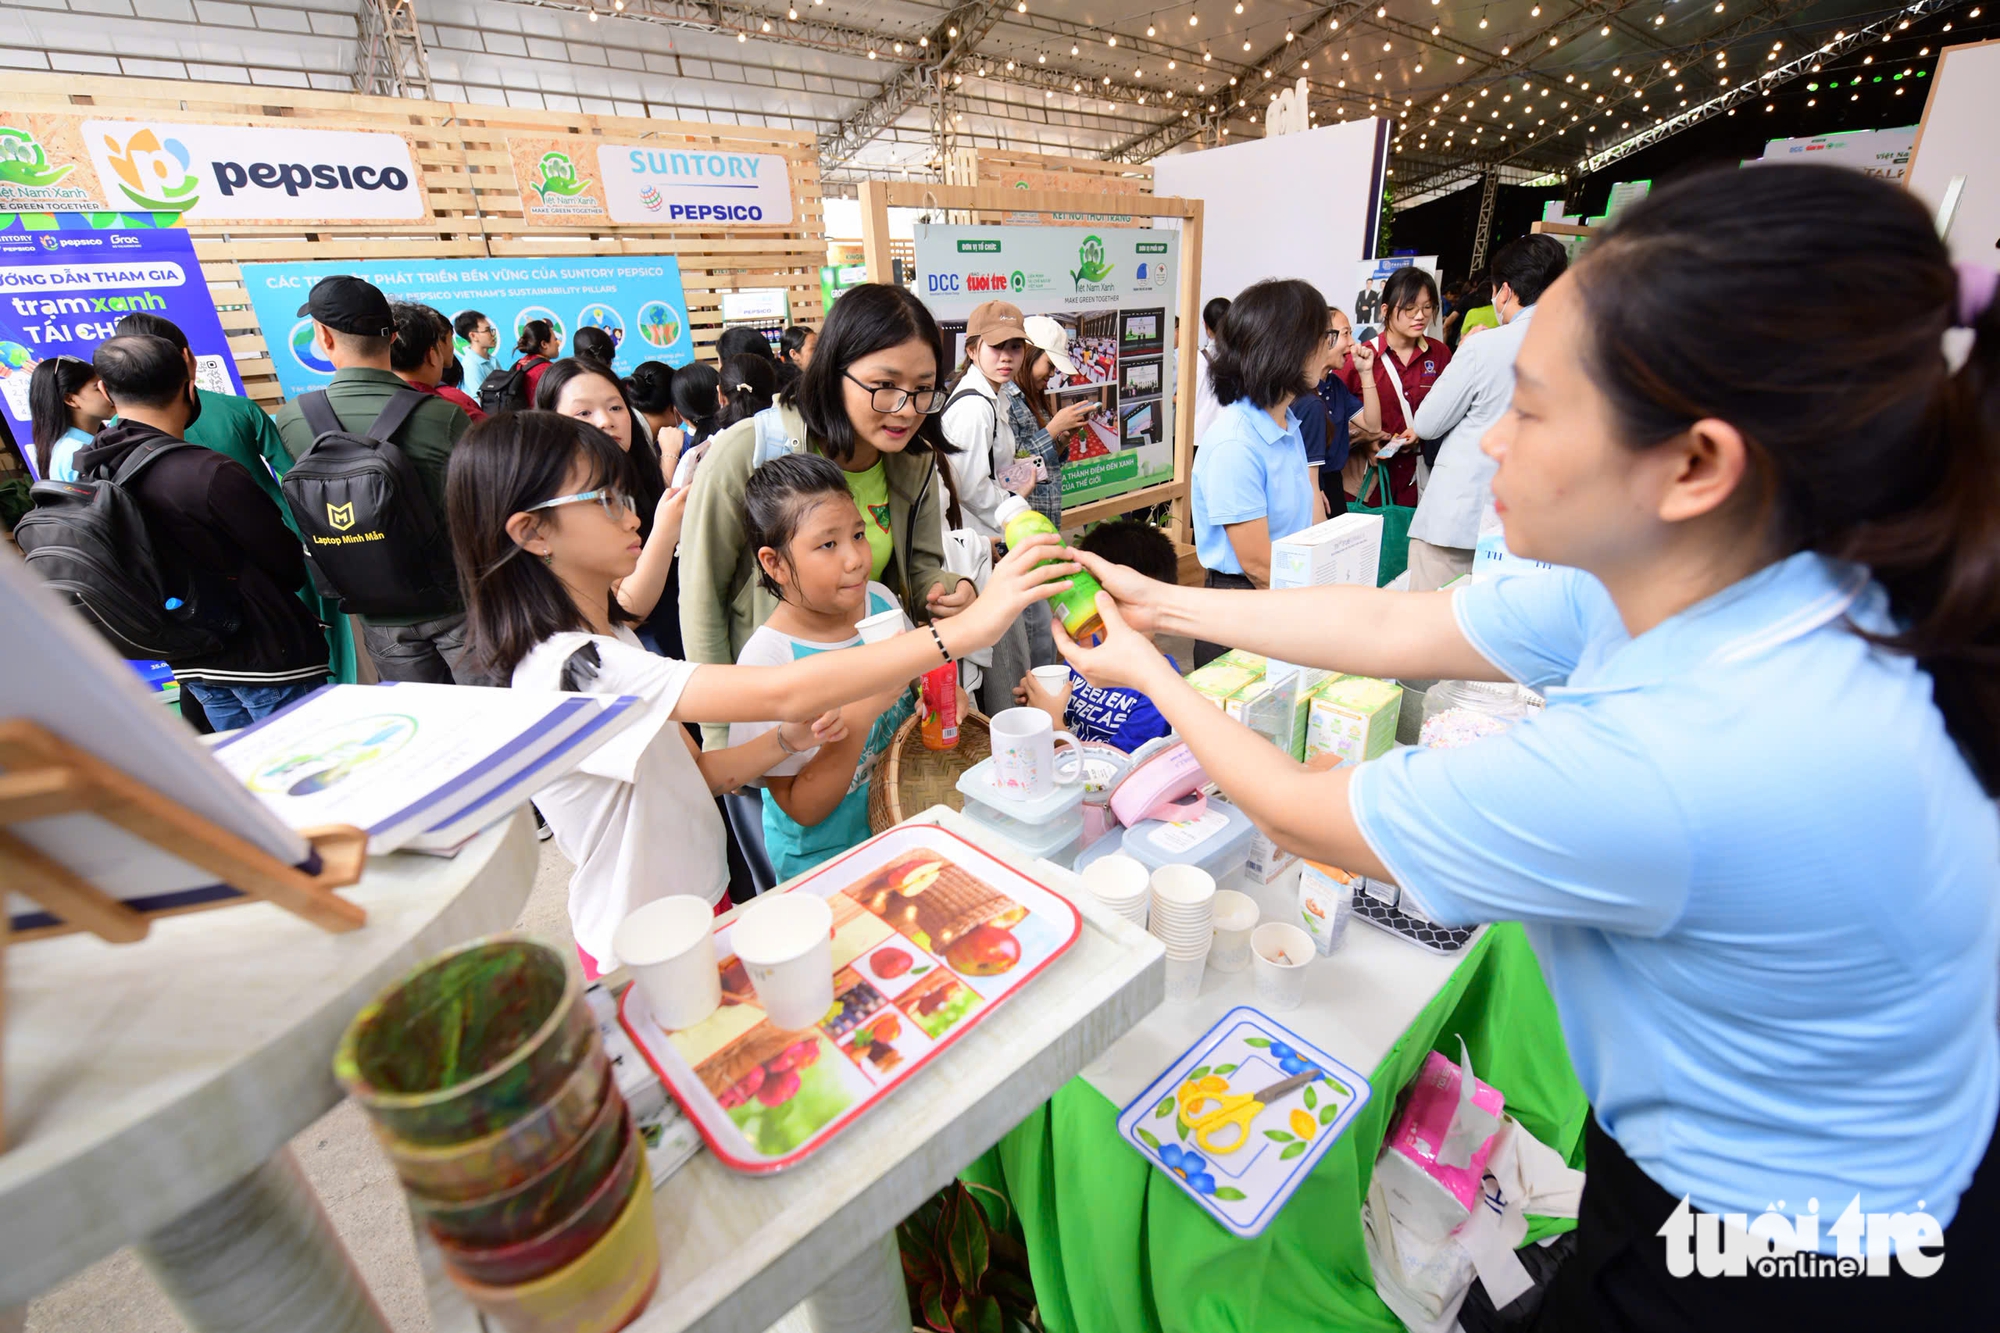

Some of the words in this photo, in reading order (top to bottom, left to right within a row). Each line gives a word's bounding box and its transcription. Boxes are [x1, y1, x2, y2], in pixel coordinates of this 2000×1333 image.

[1897, 151, 1909, 159] Na
[211, 161, 408, 197] pepsico
[18, 187, 50, 198] Nam
[53, 187, 87, 198] Xanh
[557, 196, 575, 205] Nam
[577, 196, 597, 205] Xanh
[669, 204, 763, 221] PEPSICO
[60, 239, 103, 247] pepsico
[50, 268, 91, 284] DẪN
[93, 270, 145, 282] THAM
[148, 269, 179, 281] GIA
[266, 275, 301, 289] CÁC
[374, 272, 413, 285] PHÁT
[491, 267, 529, 281] VỮNG
[532, 266, 558, 280] CỦA
[561, 268, 614, 279] SUNTORY
[617, 266, 663, 277] PEPSICO
[928, 273, 960, 292] DCC
[406, 291, 451, 301] PEPSICO
[454, 288, 507, 299] VIETNAM'S
[508, 286, 581, 297] SUSTAINABILITY
[582, 285, 617, 294] PILLARS
[1087, 284, 1100, 292] Nam
[1101, 283, 1115, 292] Xanh
[23, 319, 73, 344] TÁI
[75, 314, 126, 341] CH
[1068, 469, 1090, 480] THÀNH
[1090, 465, 1106, 475] ĐIỂM
[1106, 461, 1118, 471] ĐẾN
[1119, 458, 1134, 467] XANH
[1062, 483, 1075, 491] CỦA
[1076, 478, 1088, 488] THẾ
[1089, 475, 1101, 484] GIỚI
[313, 535, 342, 546] Laptop
[342, 534, 365, 544] Minh
[1072, 674, 1138, 714] WEEKEN
